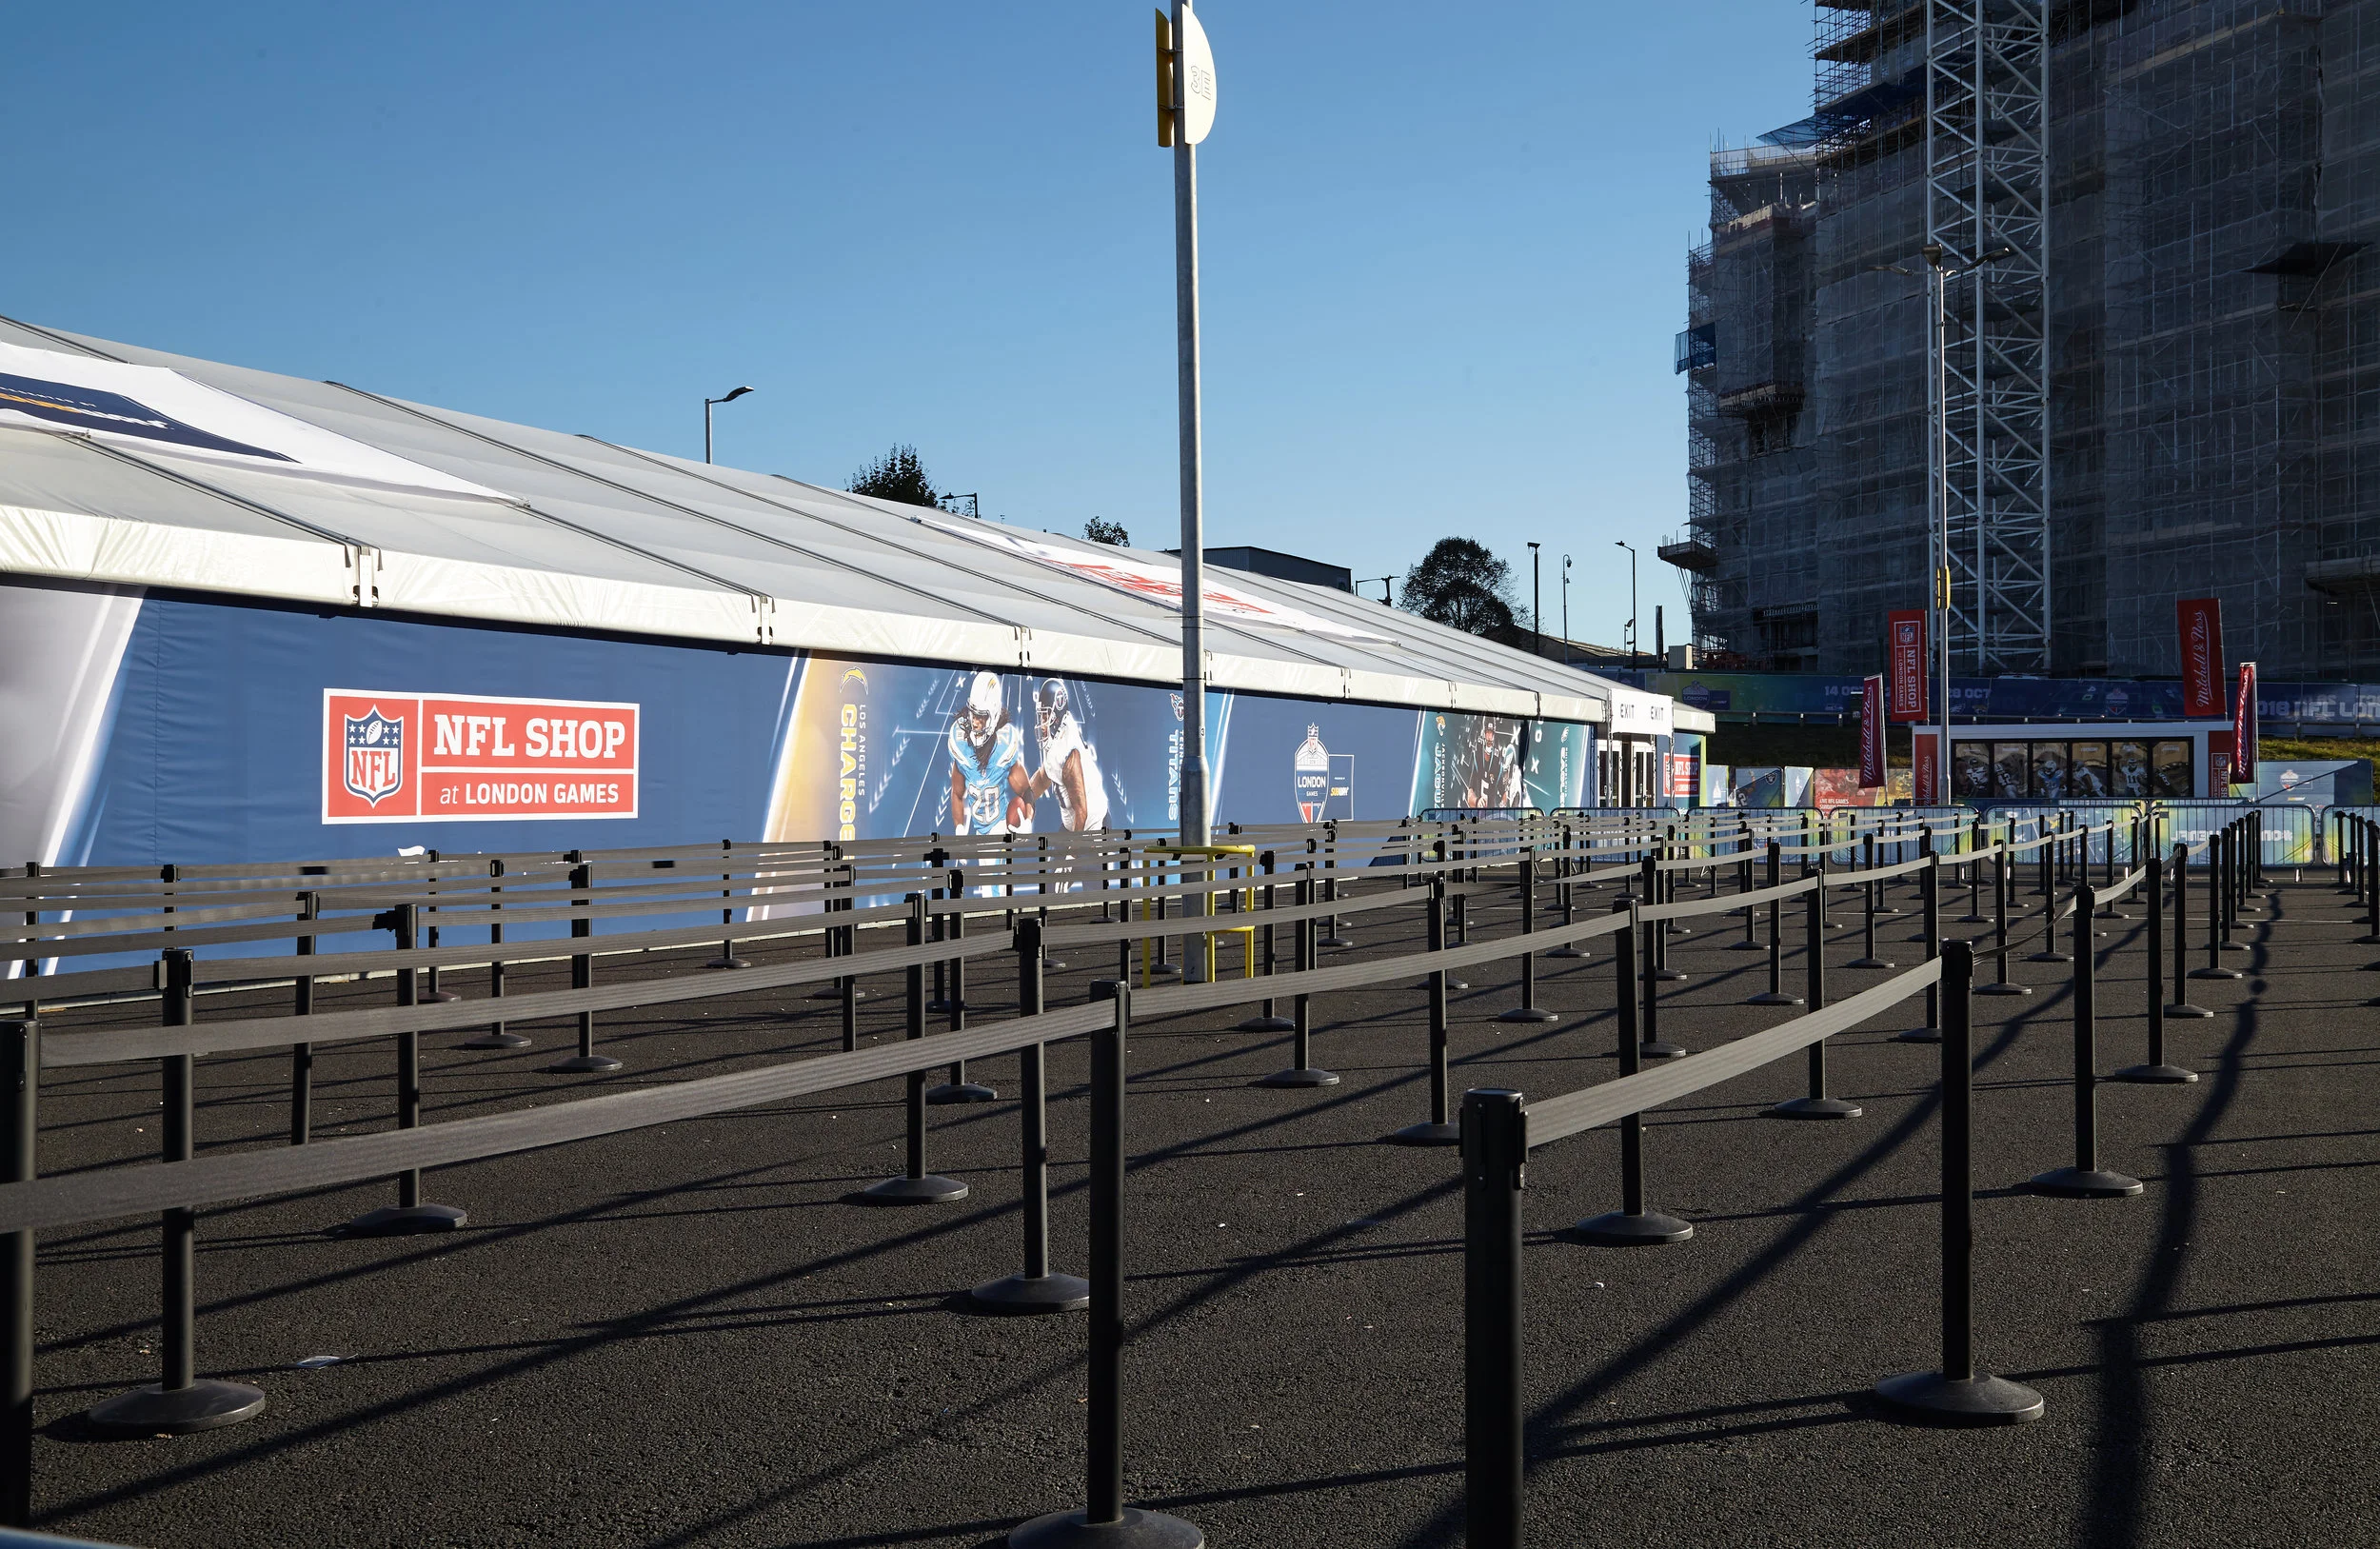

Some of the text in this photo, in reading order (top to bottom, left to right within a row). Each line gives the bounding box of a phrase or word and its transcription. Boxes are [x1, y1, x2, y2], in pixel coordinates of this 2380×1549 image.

[2191, 609, 2205, 642] Ness
[1824, 685, 1838, 696] 14
[1907, 649, 1917, 708] NFL SHOP
[1964, 687, 1992, 699] OCT
[2193, 651, 2209, 707] Mitchell
[1619, 704, 1635, 719] EXIT
[1650, 705, 1664, 720] EXIT
[2257, 701, 2290, 716] 018
[433, 713, 625, 759] NFL SHOP
[1862, 728, 1874, 782] Mitchell
[351, 750, 396, 792] NFL
[840, 704, 858, 861] CHARGE
[858, 734, 866, 797] ANGELES
[1168, 728, 1180, 821] TITANS
[1298, 776, 1326, 788] LONDON
[1434, 743, 1442, 808] JAGU
[440, 783, 619, 805] at LONDON GAMES
[968, 784, 1001, 824] 20
